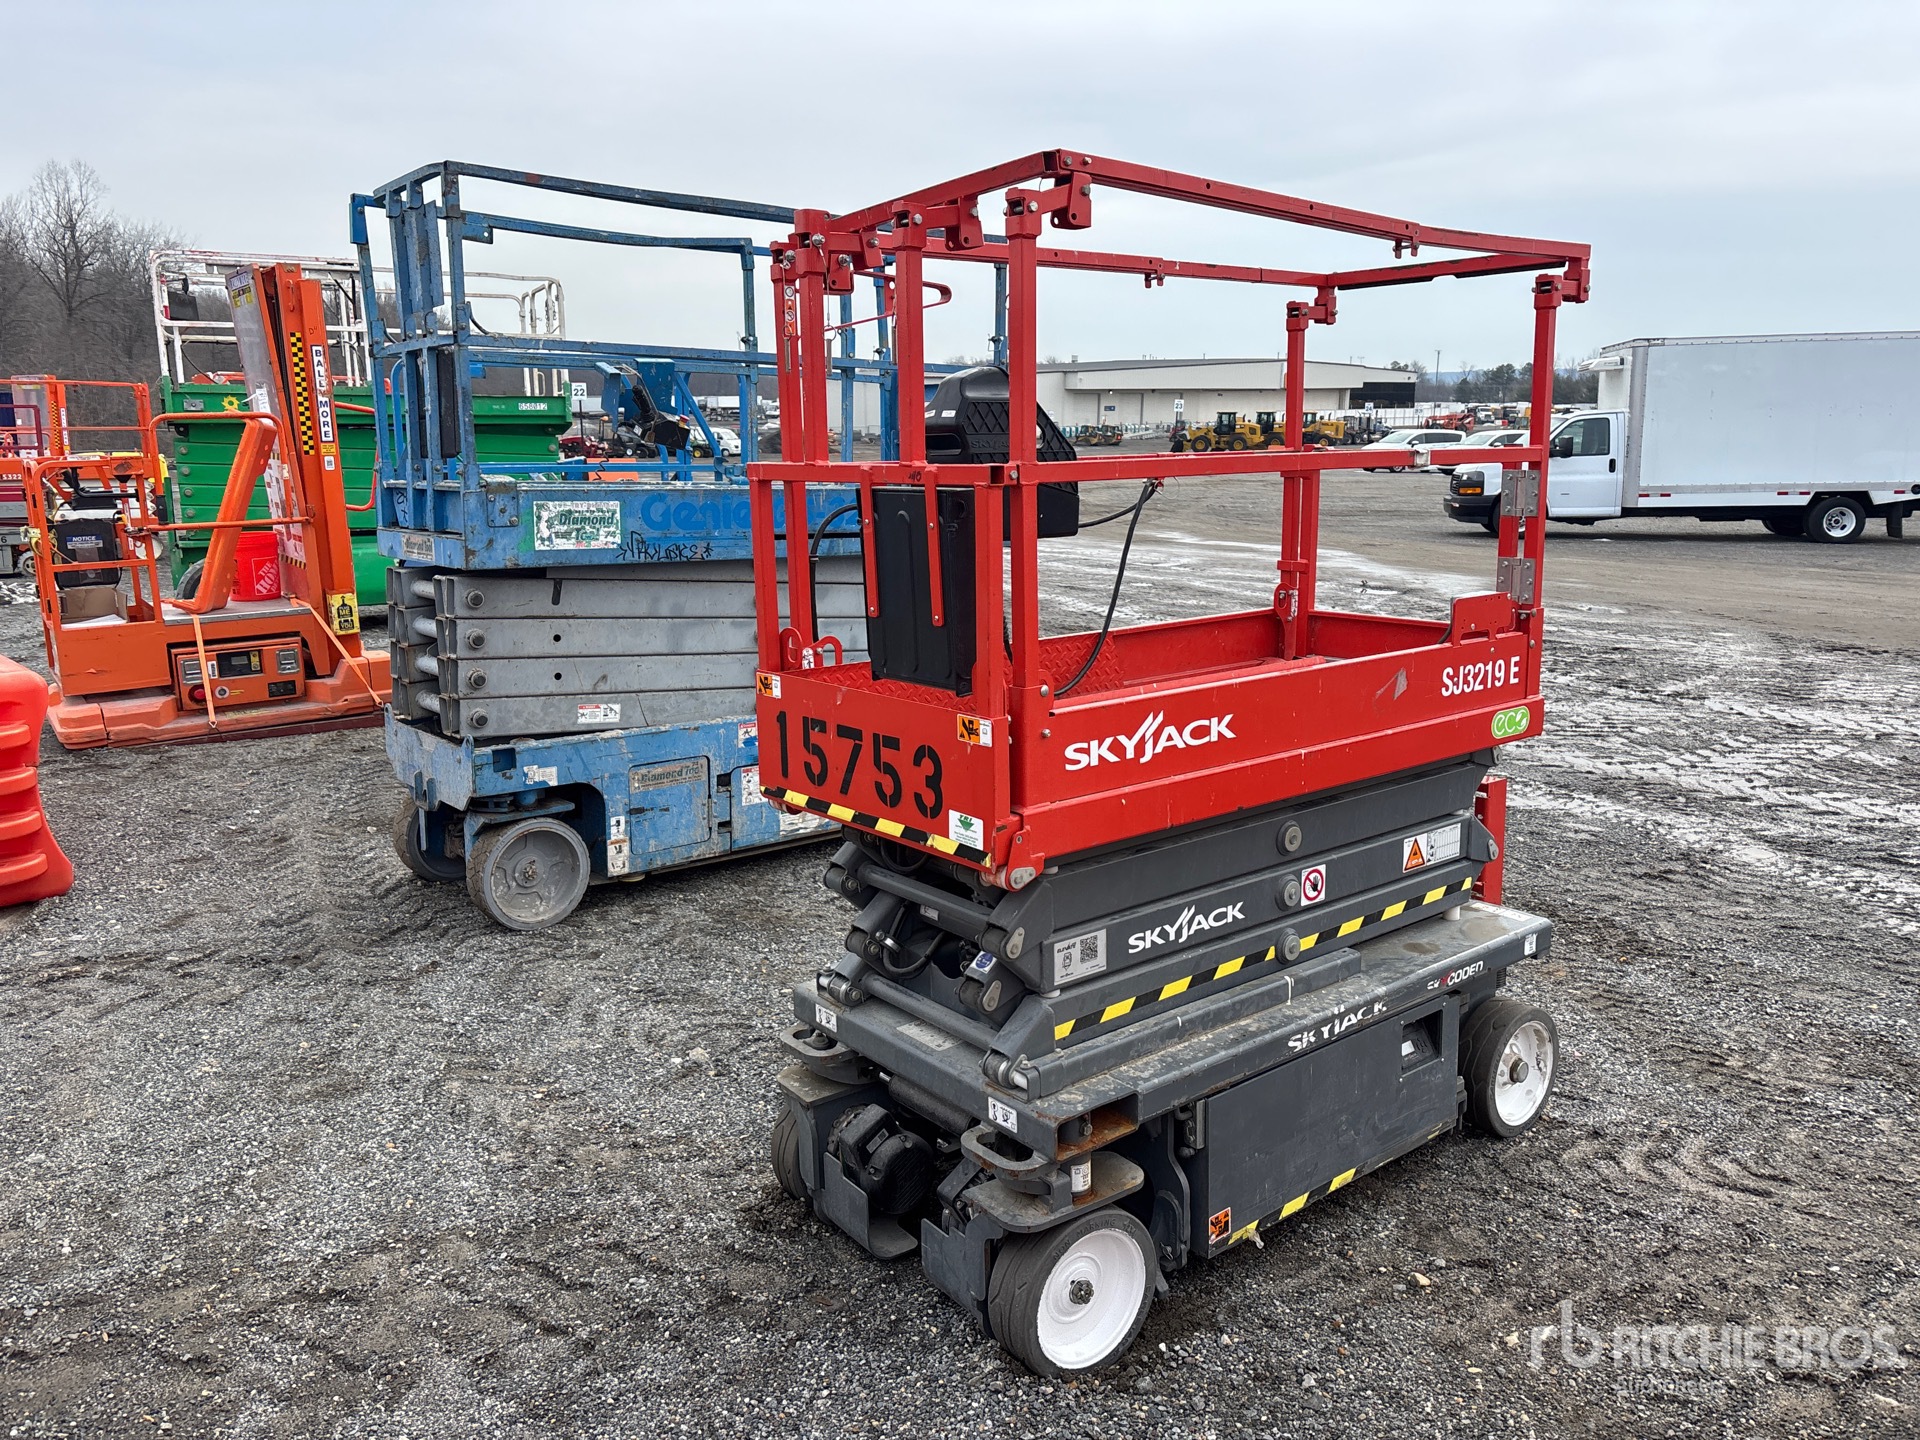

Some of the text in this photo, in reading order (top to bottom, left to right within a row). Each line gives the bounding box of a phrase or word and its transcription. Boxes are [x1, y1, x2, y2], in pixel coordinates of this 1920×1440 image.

[573, 388, 586, 397] 22
[1175, 402, 1183, 410] 23
[559, 512, 615, 526] Diamond
[1441, 655, 1521, 697] SJ3219 E
[1494, 709, 1528, 735] eco
[1064, 710, 1237, 772] SKYJACK
[776, 710, 943, 820] 15753
[959, 814, 973, 823] TRI
[1128, 901, 1246, 954] SKYJACK
